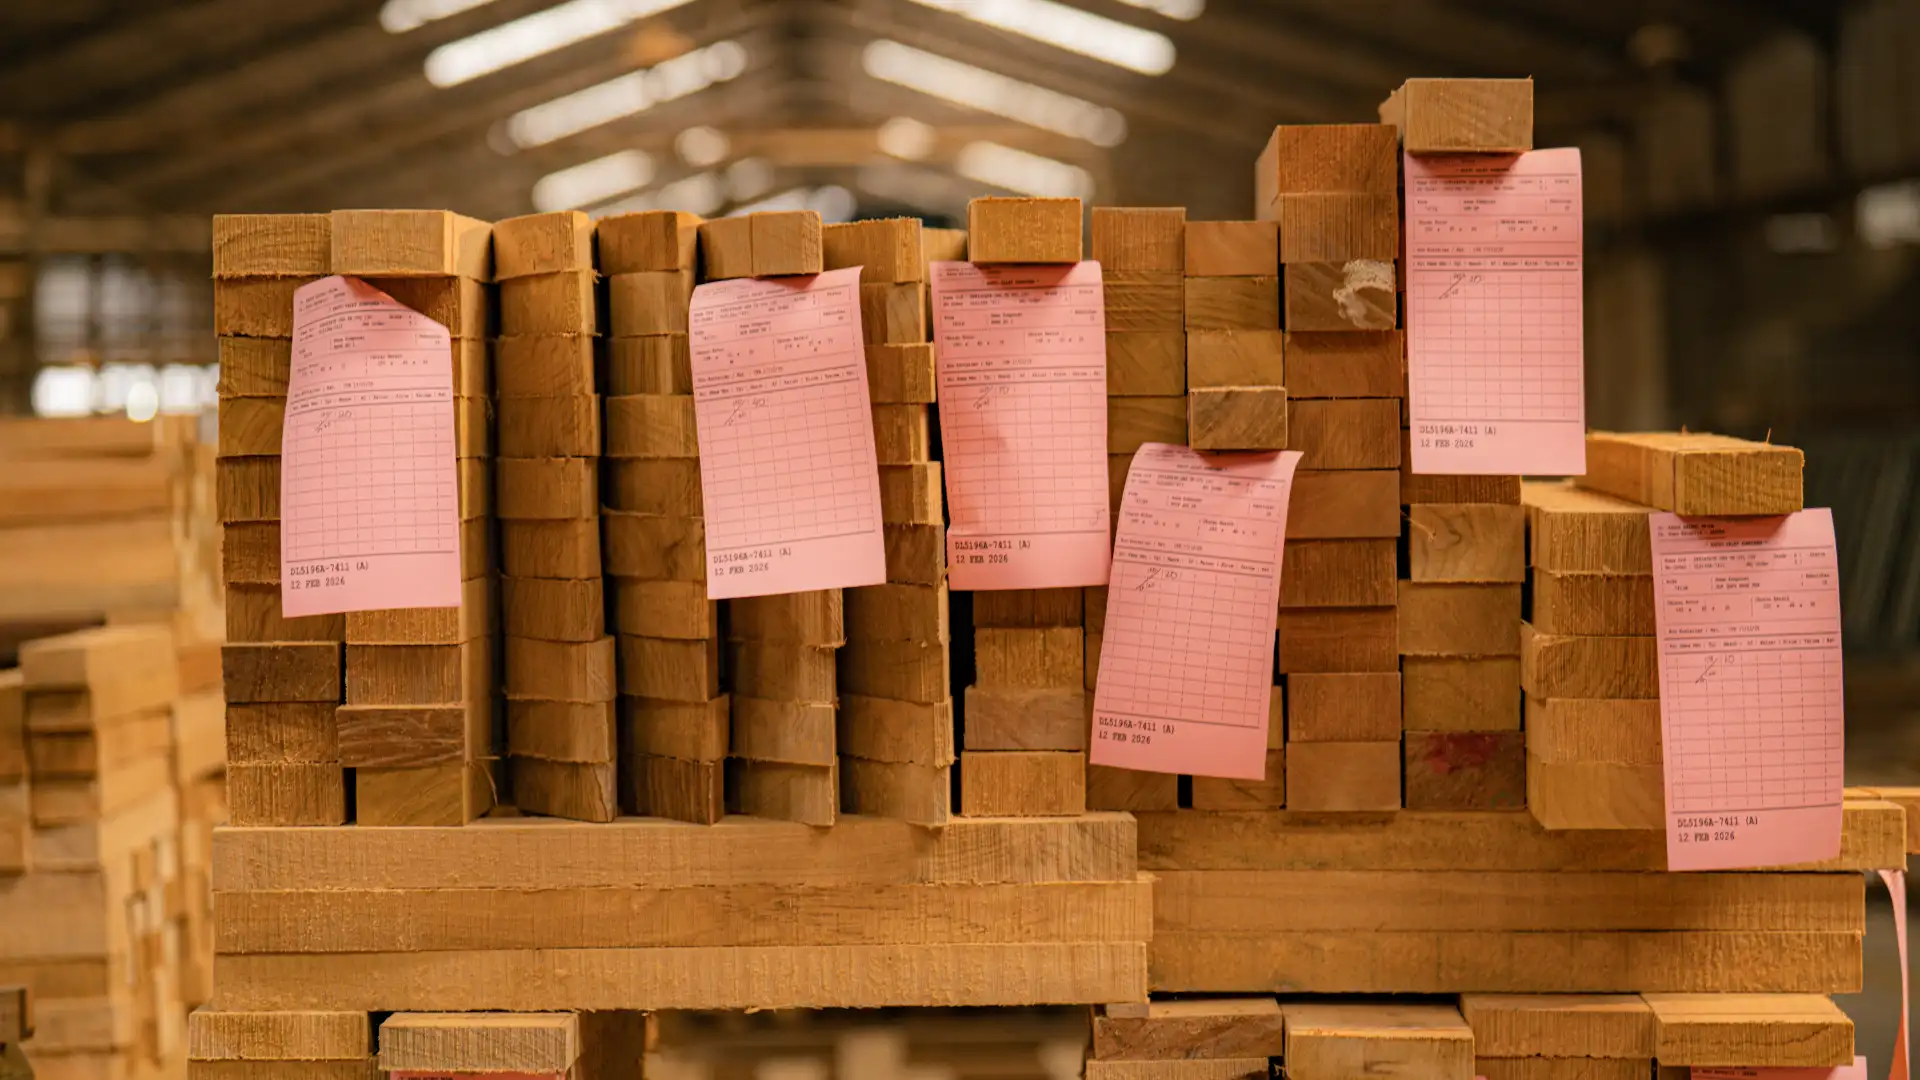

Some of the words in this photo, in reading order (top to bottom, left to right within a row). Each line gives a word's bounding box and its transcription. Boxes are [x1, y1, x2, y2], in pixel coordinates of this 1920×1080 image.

[1484, 425, 1497, 436] (A)
[1420, 439, 1430, 448] 12
[1435, 439, 1450, 448] FEB
[1454, 439, 1474, 448] 2026
[1018, 540, 1031, 549] (A)
[779, 547, 792, 556] (A)
[956, 555, 965, 564] 12
[969, 555, 984, 563] FEB
[988, 554, 1008, 563] 2026
[356, 561, 369, 571] (A)
[714, 568, 724, 576] 12
[728, 566, 744, 575] FEB
[748, 563, 769, 573] 2026
[291, 580, 301, 590] 12
[305, 579, 321, 588] FEB
[325, 576, 345, 587] 2026
[1162, 724, 1175, 735] (A)
[1098, 730, 1108, 739] 12
[1112, 732, 1127, 741] FEB
[1131, 734, 1151, 744] 2026
[1745, 816, 1758, 826] (A)
[1678, 833, 1689, 842] 12
[1694, 832, 1709, 842] FEB
[1714, 831, 1735, 841] 2026
